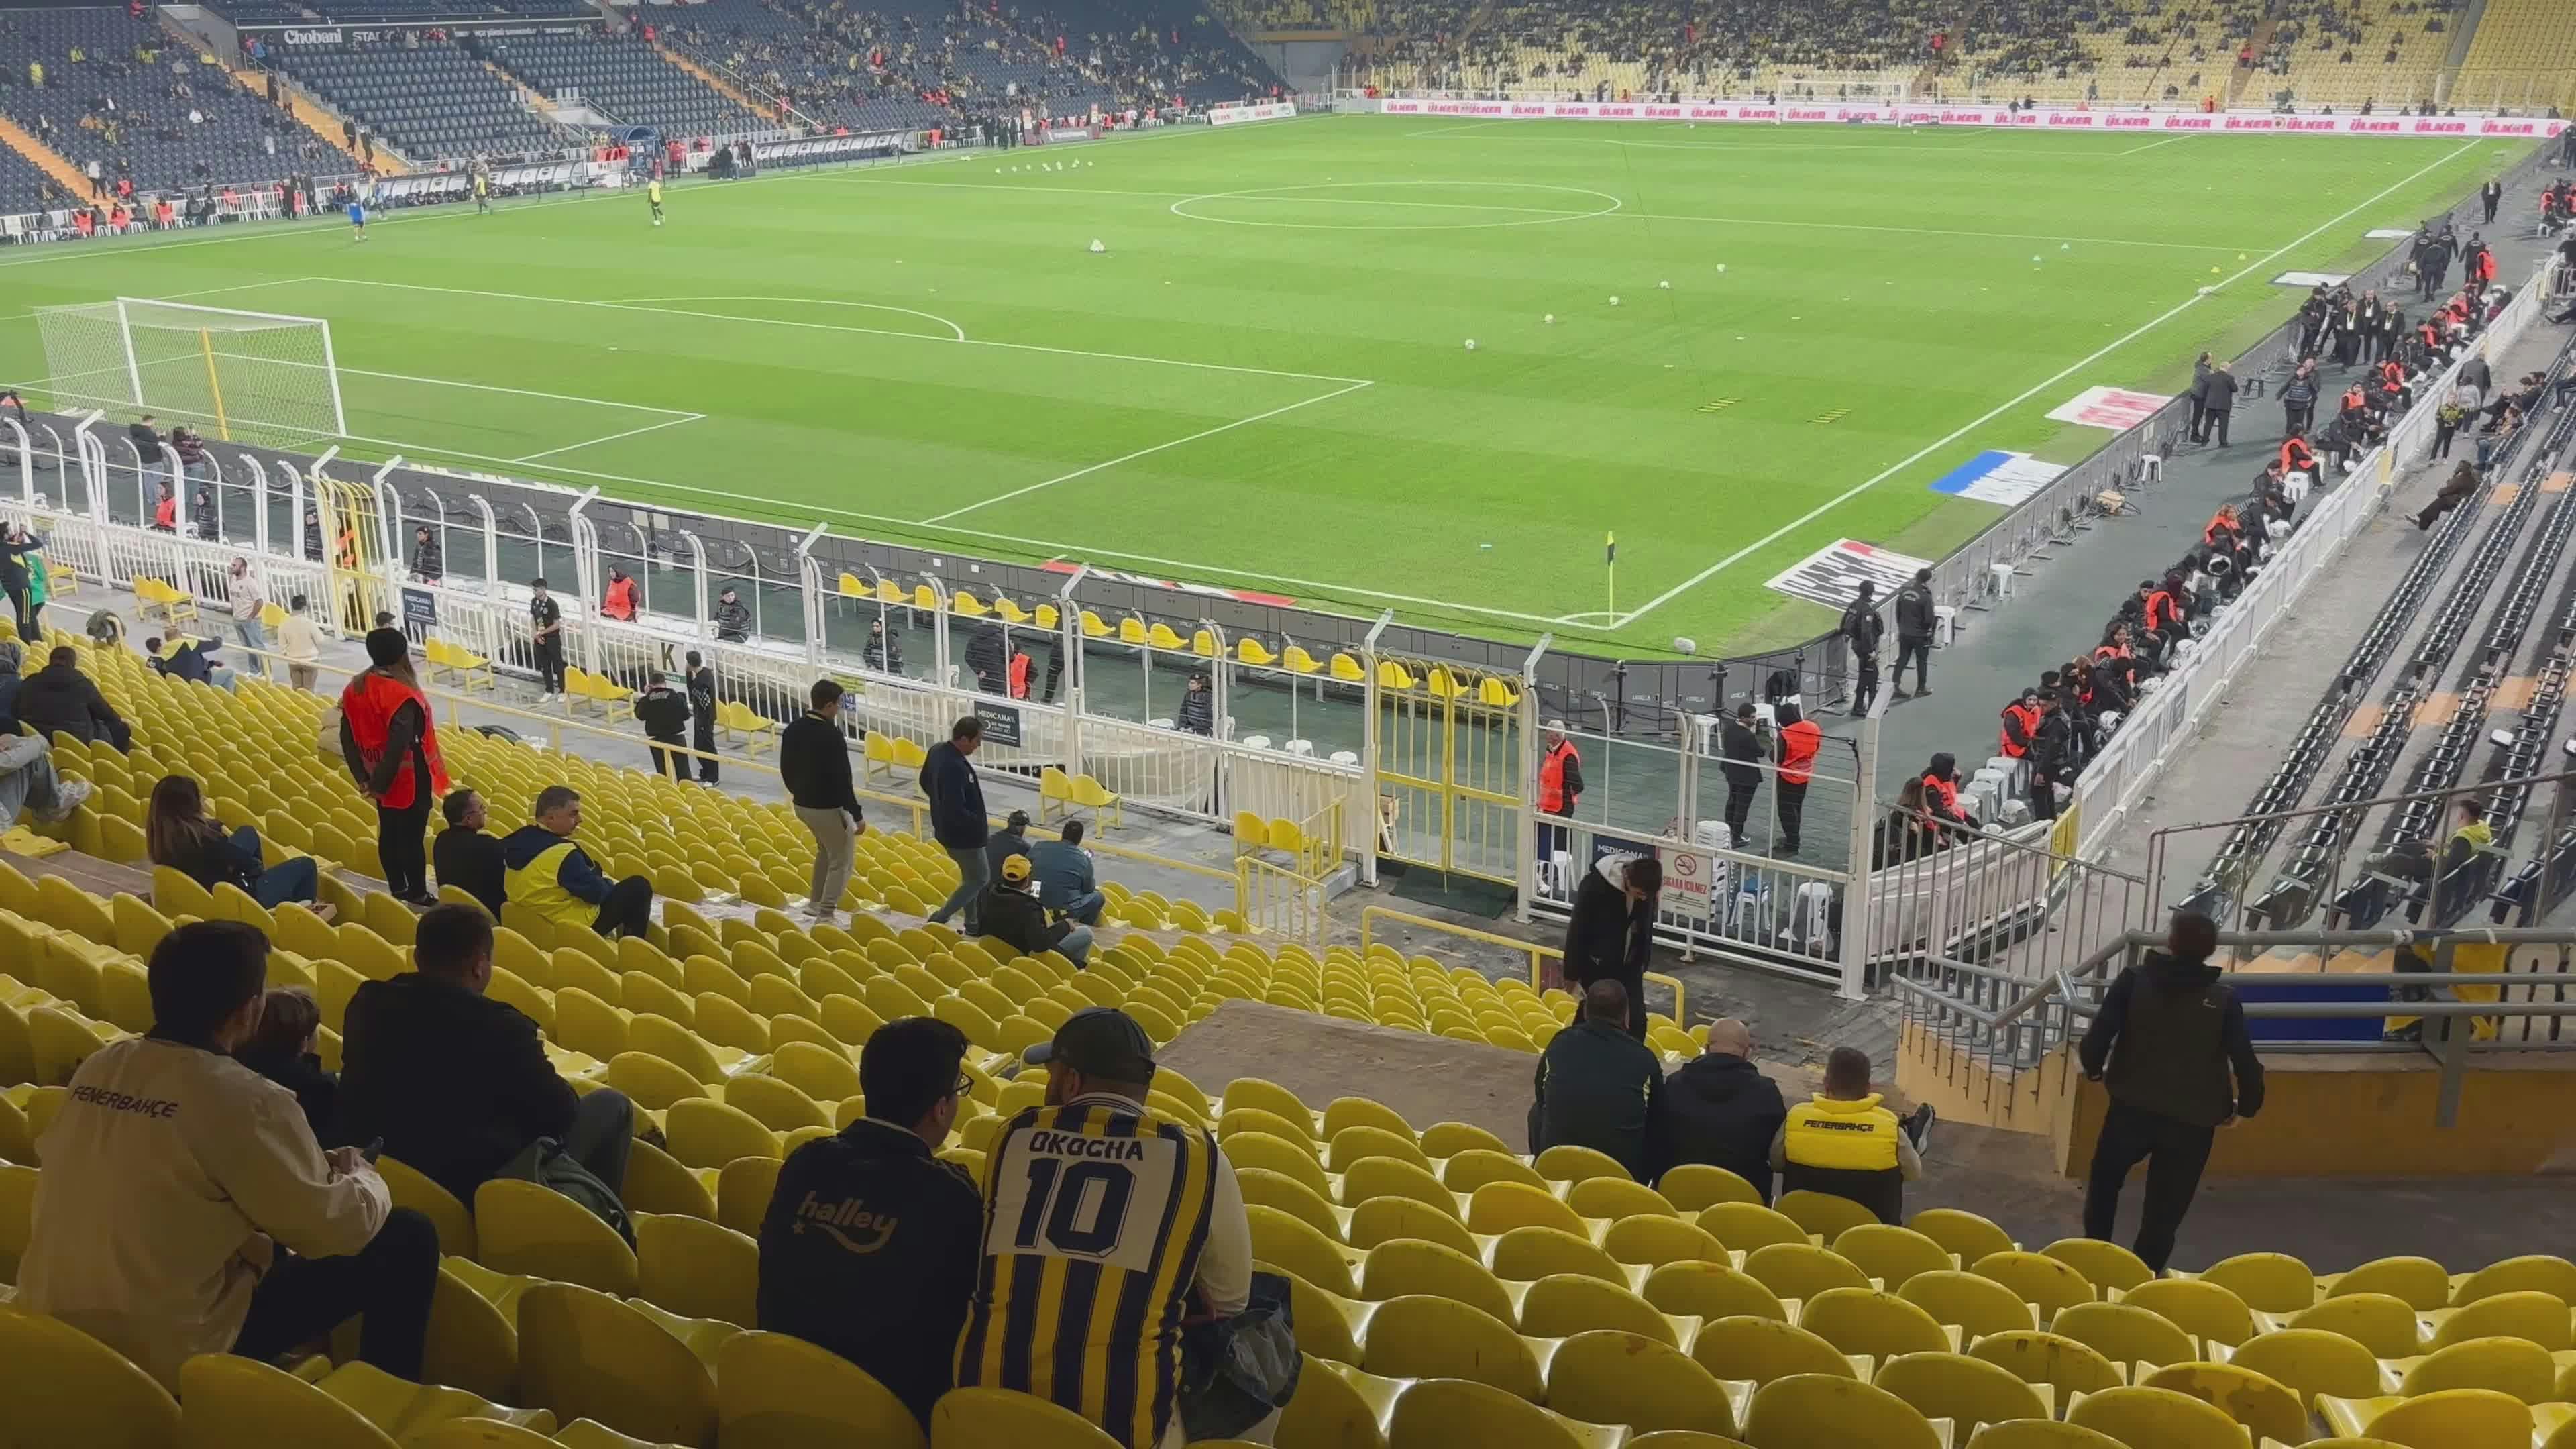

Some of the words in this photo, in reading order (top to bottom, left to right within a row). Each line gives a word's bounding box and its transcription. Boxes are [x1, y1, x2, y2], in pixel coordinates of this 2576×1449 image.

[284, 28, 343, 44] Chobani
[661, 642, 677, 672] K
[71, 1086, 178, 1118] FENERBAHÇE
[1803, 1120, 1874, 1132] FENERBAHÇE
[1029, 1132, 1144, 1161] OKOCHA
[796, 1191, 898, 1236] halley
[1015, 1158, 1136, 1258] 10
